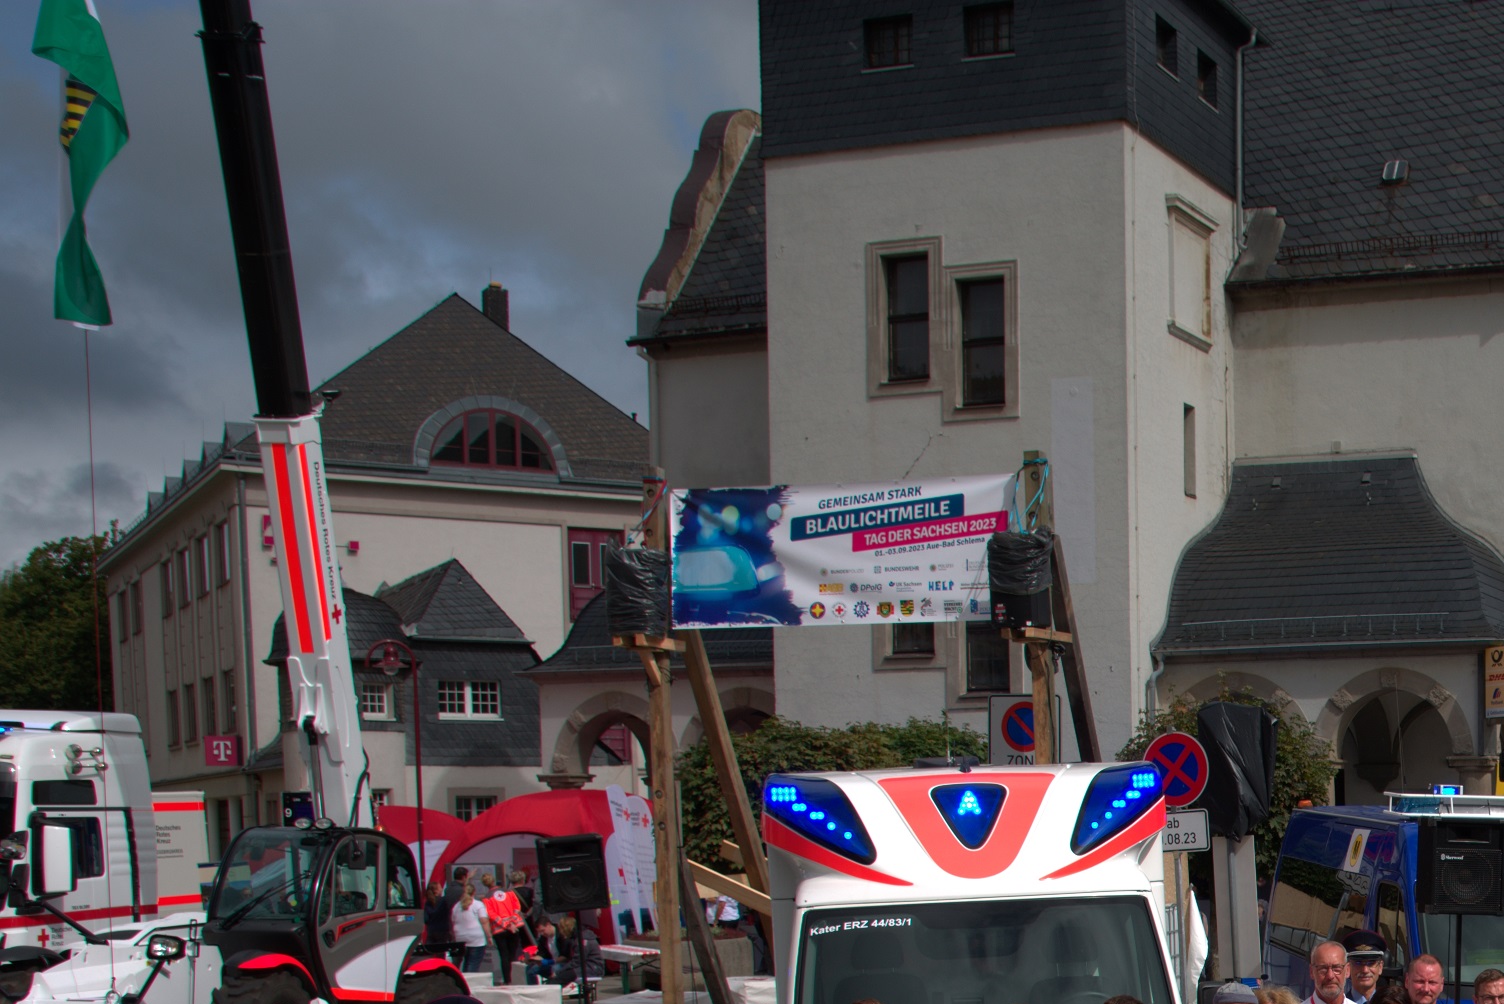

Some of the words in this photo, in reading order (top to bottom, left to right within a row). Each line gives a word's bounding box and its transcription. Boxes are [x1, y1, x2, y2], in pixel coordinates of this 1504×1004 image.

[818, 491, 885, 510] GEMEINSAM
[888, 485, 923, 500] STARK
[806, 500, 950, 535] BLAULICHTMEILE
[313, 461, 327, 525] Deutsches
[322, 528, 332, 563] Rotes
[328, 566, 338, 600] Kreuz
[864, 532, 887, 546] TAG
[888, 528, 911, 543] DER
[913, 521, 968, 540] SACHSEN
[970, 517, 997, 533] 2023
[874, 543, 925, 558] 01.-03.09.2023
[926, 538, 956, 550] Aue-Bad
[956, 536, 986, 547] Schlema
[884, 564, 920, 573] BUNDESWEHR
[860, 582, 883, 592] DPolG
[928, 580, 955, 592] HELP
[212, 740, 233, 762] T
[1007, 755, 1034, 766] ZON
[285, 807, 293, 819] 9
[1166, 817, 1180, 829] ab
[810, 923, 842, 937] Kater
[843, 920, 869, 931] ERZ
[870, 917, 912, 929] 44/83/1
